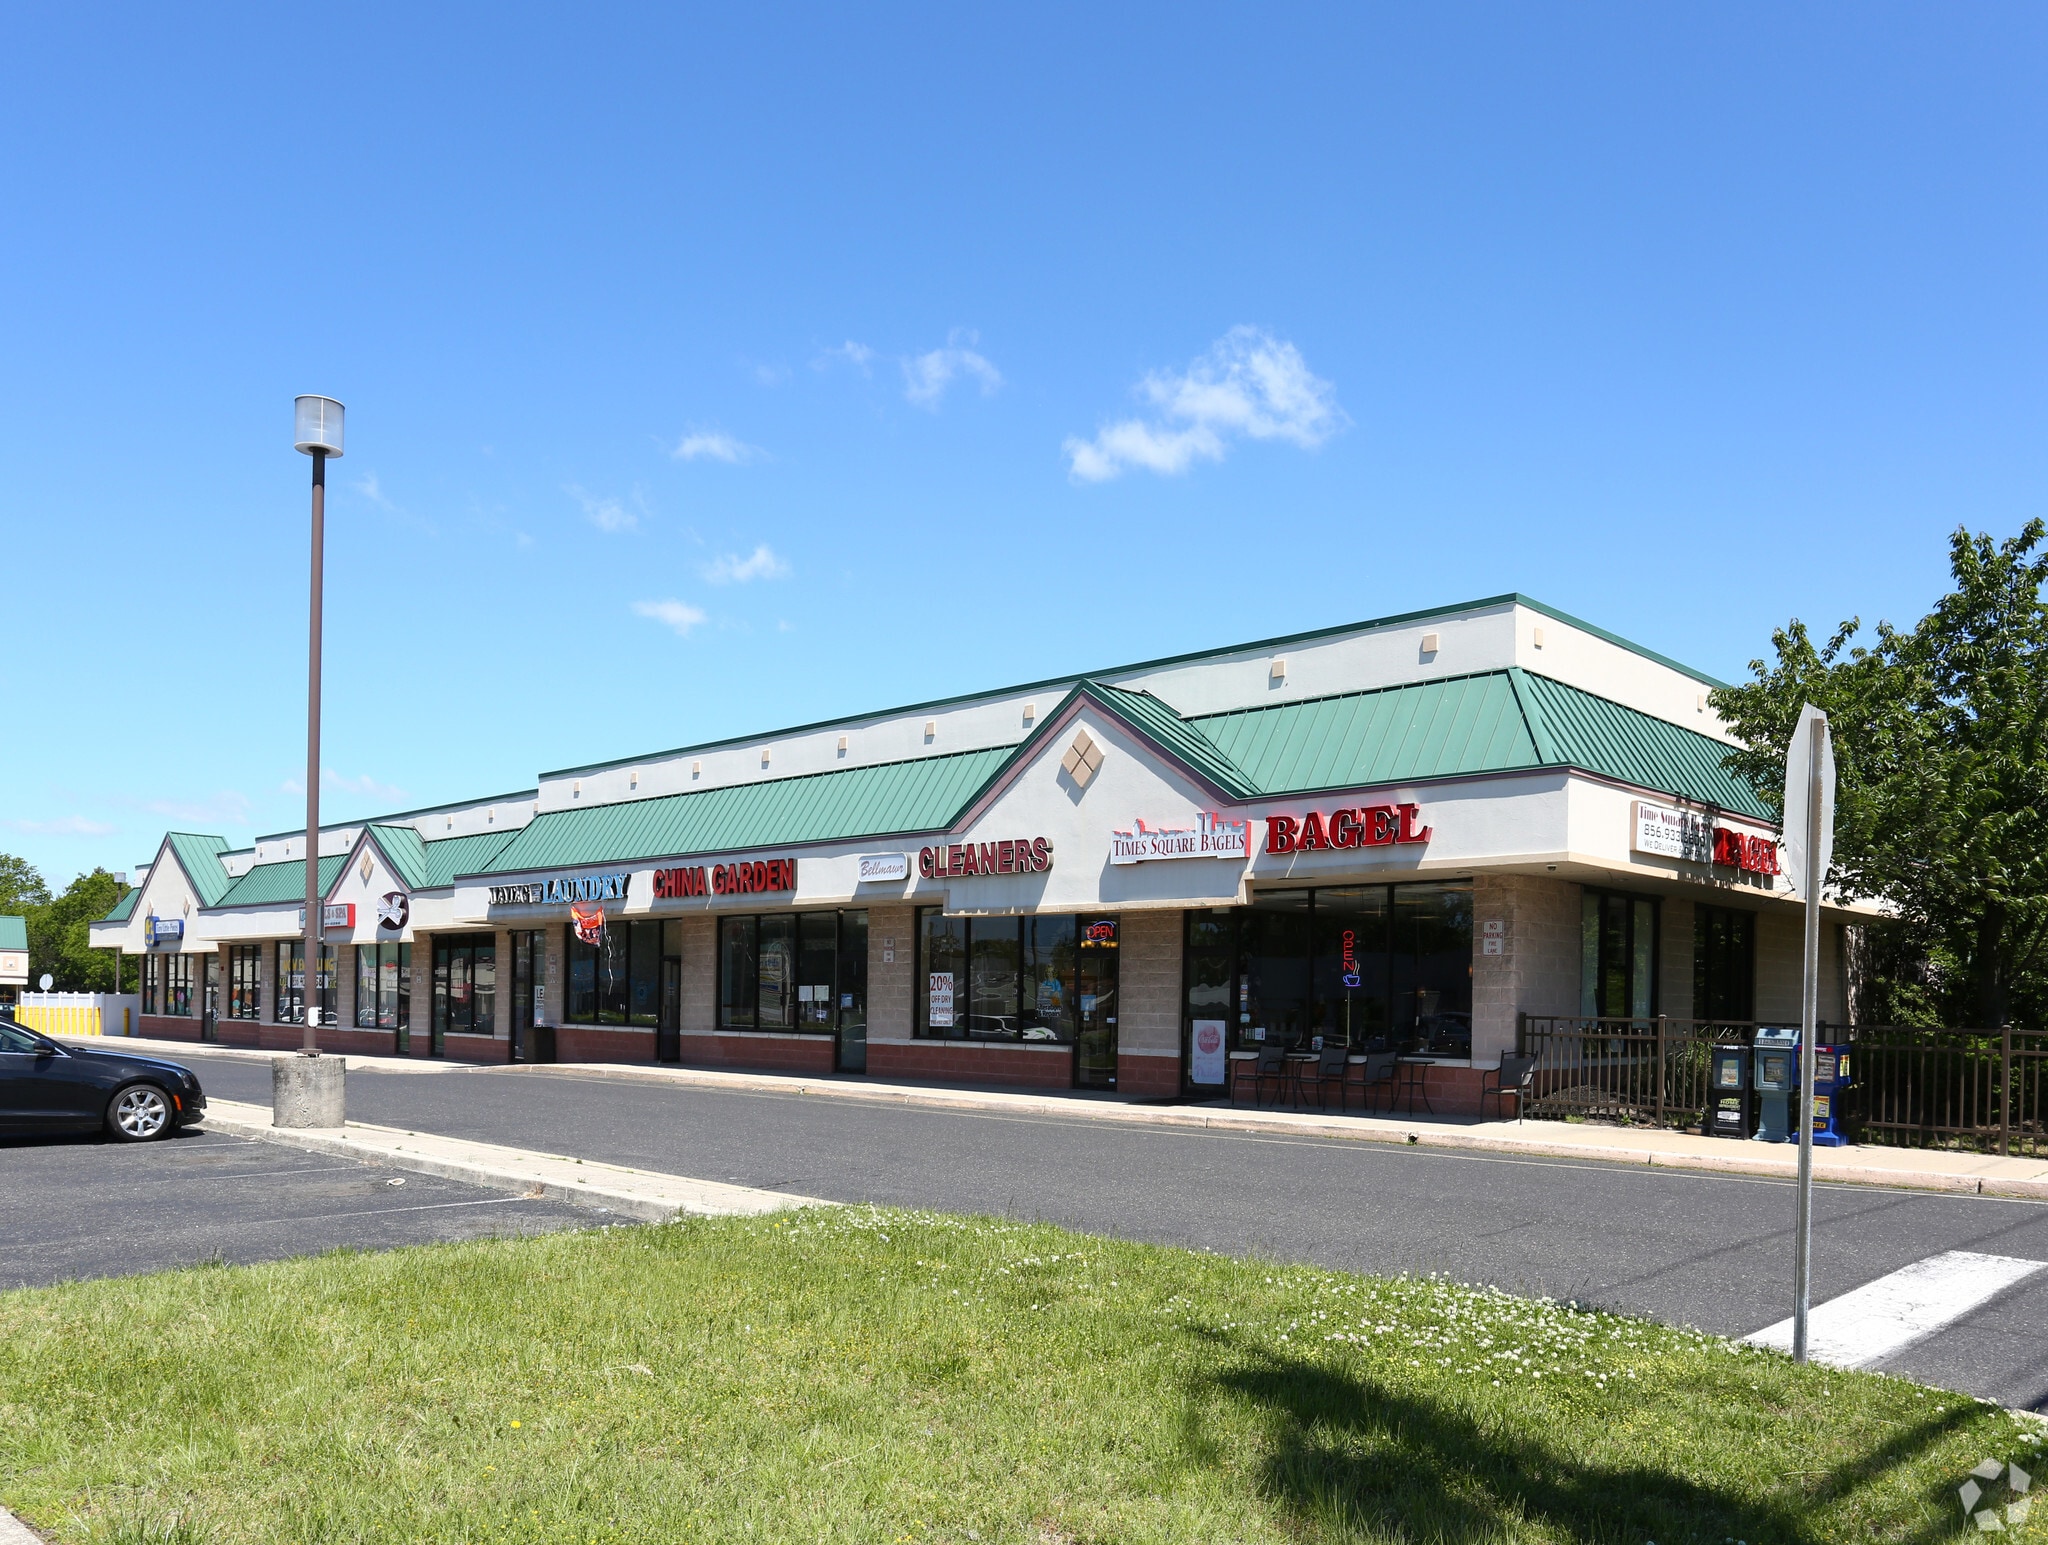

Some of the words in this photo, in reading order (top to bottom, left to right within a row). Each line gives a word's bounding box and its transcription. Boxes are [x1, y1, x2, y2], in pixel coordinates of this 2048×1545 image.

[1640, 806, 1658, 821] Time
[1265, 802, 1432, 855] BAGEL
[1113, 840, 1147, 856] TIMES
[1150, 837, 1196, 856] SQUARE
[1200, 833, 1245, 851] BAGELS
[918, 836, 1052, 879] CLEANERS
[860, 859, 904, 877] Bellmawr
[653, 866, 709, 898] CHINA
[712, 858, 797, 894] GARDEN
[541, 873, 630, 904] LAUNDRY
[336, 906, 346, 918] SPA
[1086, 926, 1113, 938] OPEN
[1343, 930, 1354, 970] OPEN
[930, 976, 953, 991] 20%
[931, 995, 941, 1003] OFF
[941, 995, 951, 1003] DRY
[930, 1007, 953, 1015] CLEANING
